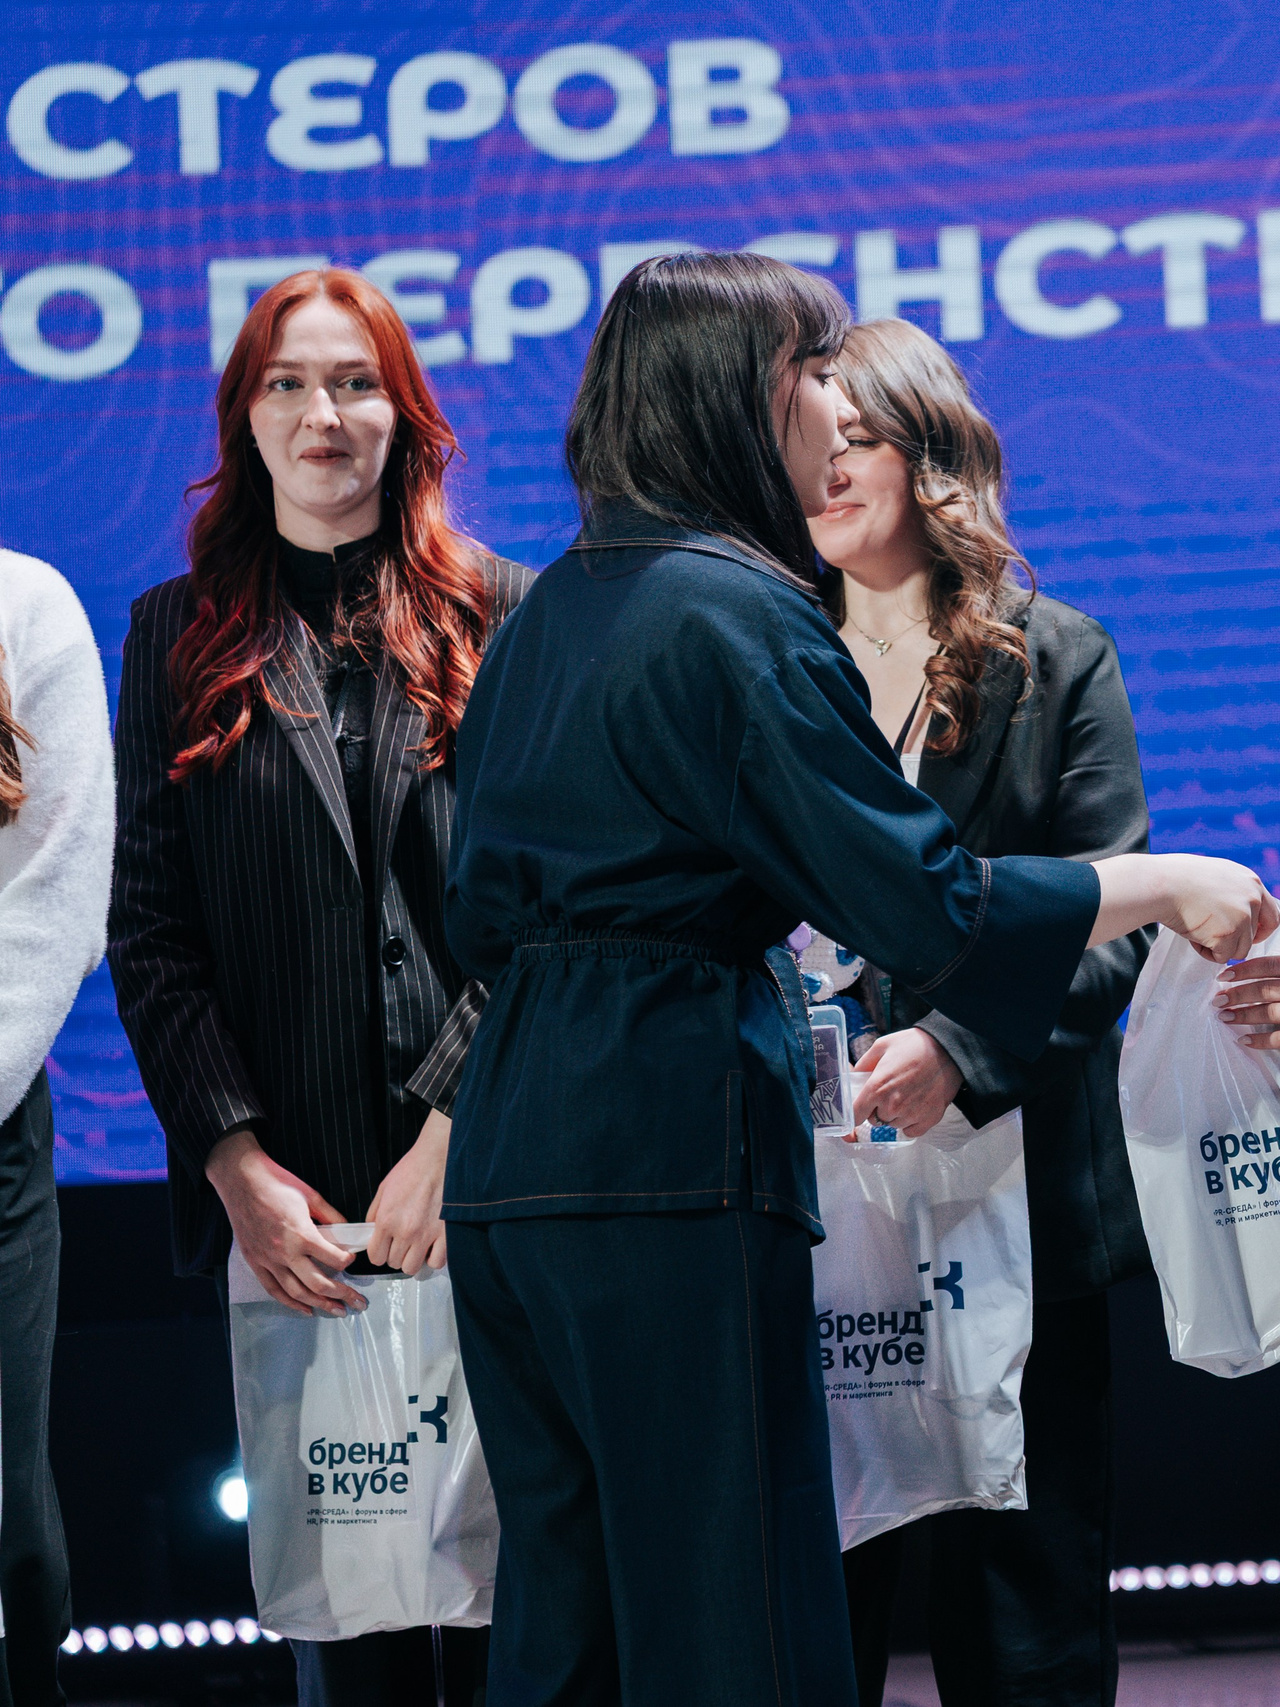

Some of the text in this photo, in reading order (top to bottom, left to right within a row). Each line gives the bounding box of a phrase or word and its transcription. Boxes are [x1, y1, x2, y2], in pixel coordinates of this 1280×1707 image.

[1205, 1170, 1224, 1195] в
[817, 1309, 925, 1343] бренд
[820, 1336, 925, 1376] в кубе
[849, 1390, 893, 1400] маркетинга
[868, 1380, 893, 1389] форум
[901, 1379, 925, 1387] сфере
[309, 1437, 409, 1469] бренд
[308, 1466, 409, 1503] в кубе
[355, 1508, 378, 1516] форум
